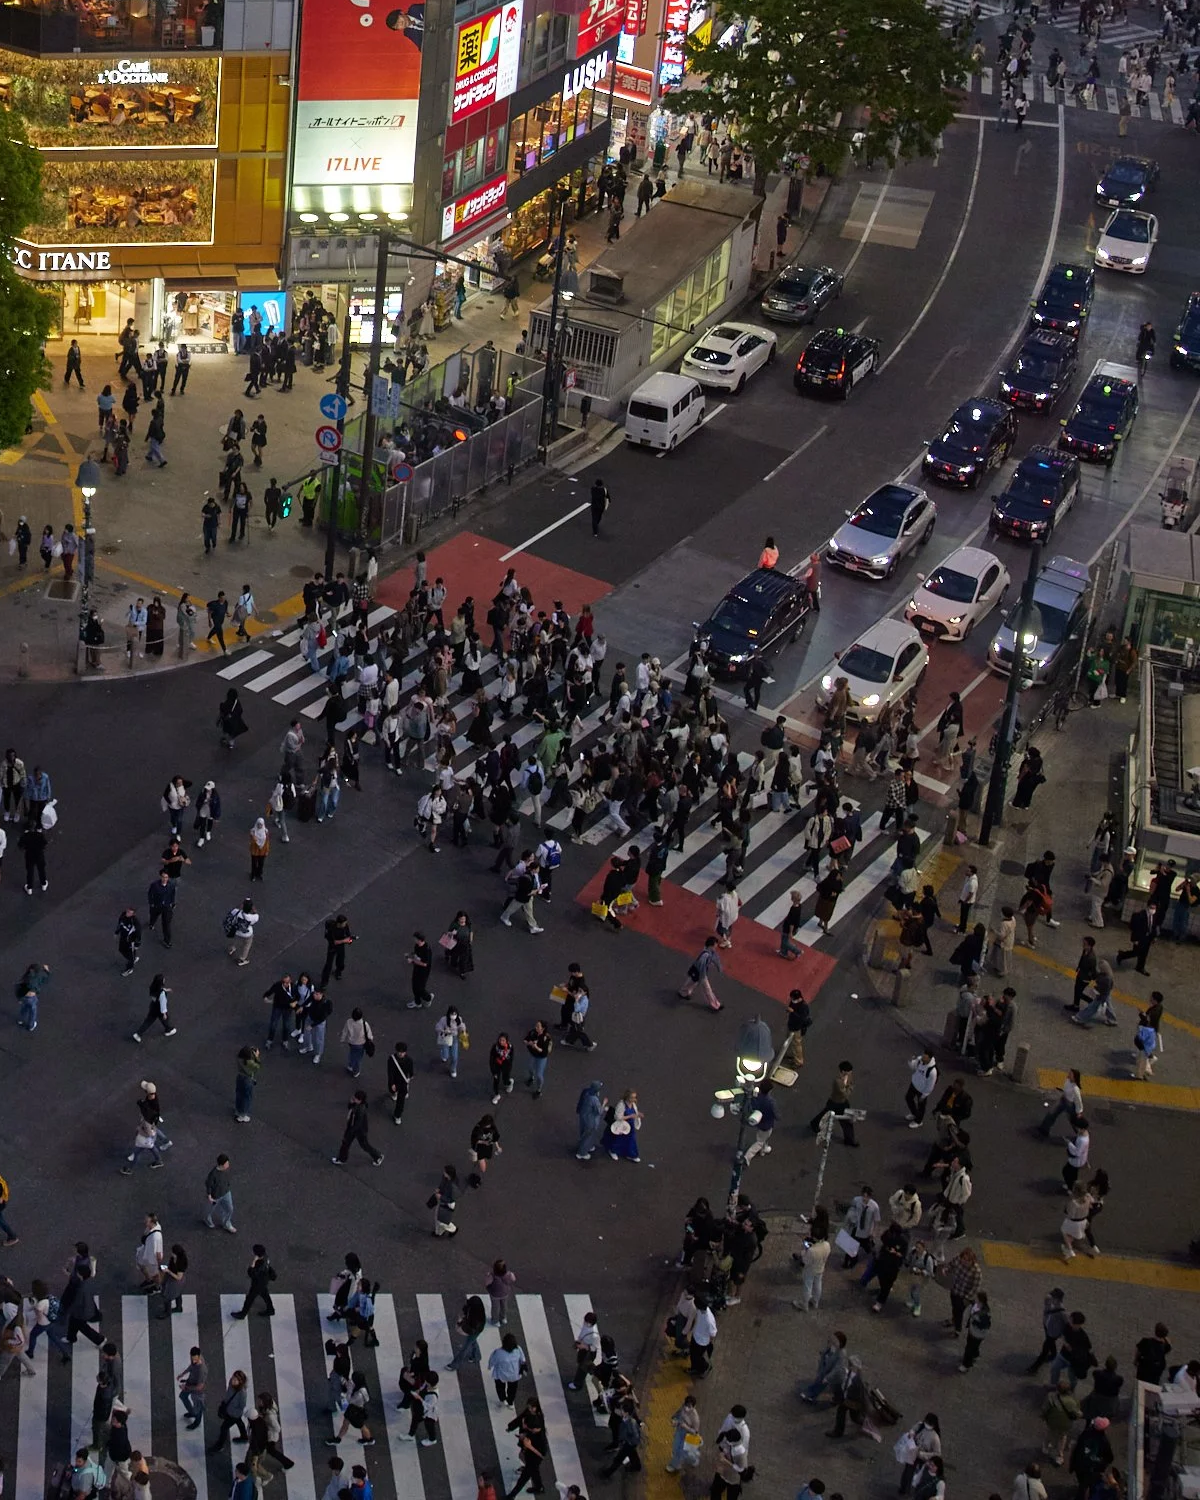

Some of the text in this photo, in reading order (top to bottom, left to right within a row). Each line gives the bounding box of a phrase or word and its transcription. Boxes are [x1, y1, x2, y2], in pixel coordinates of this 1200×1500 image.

[594, 22, 606, 43] 3F
[459, 29, 480, 72] 薬
[97, 69, 169, 85] L'OCCITANE
[455, 78, 470, 92] DRUG
[473, 62, 498, 85] COSMETIC
[561, 50, 610, 101] LUSH
[453, 75, 498, 113] サンドラッグ
[313, 115, 391, 127] オールナイトニッポン
[326, 157, 383, 172] 17LIVE
[470, 180, 507, 213] サンドラッグ
